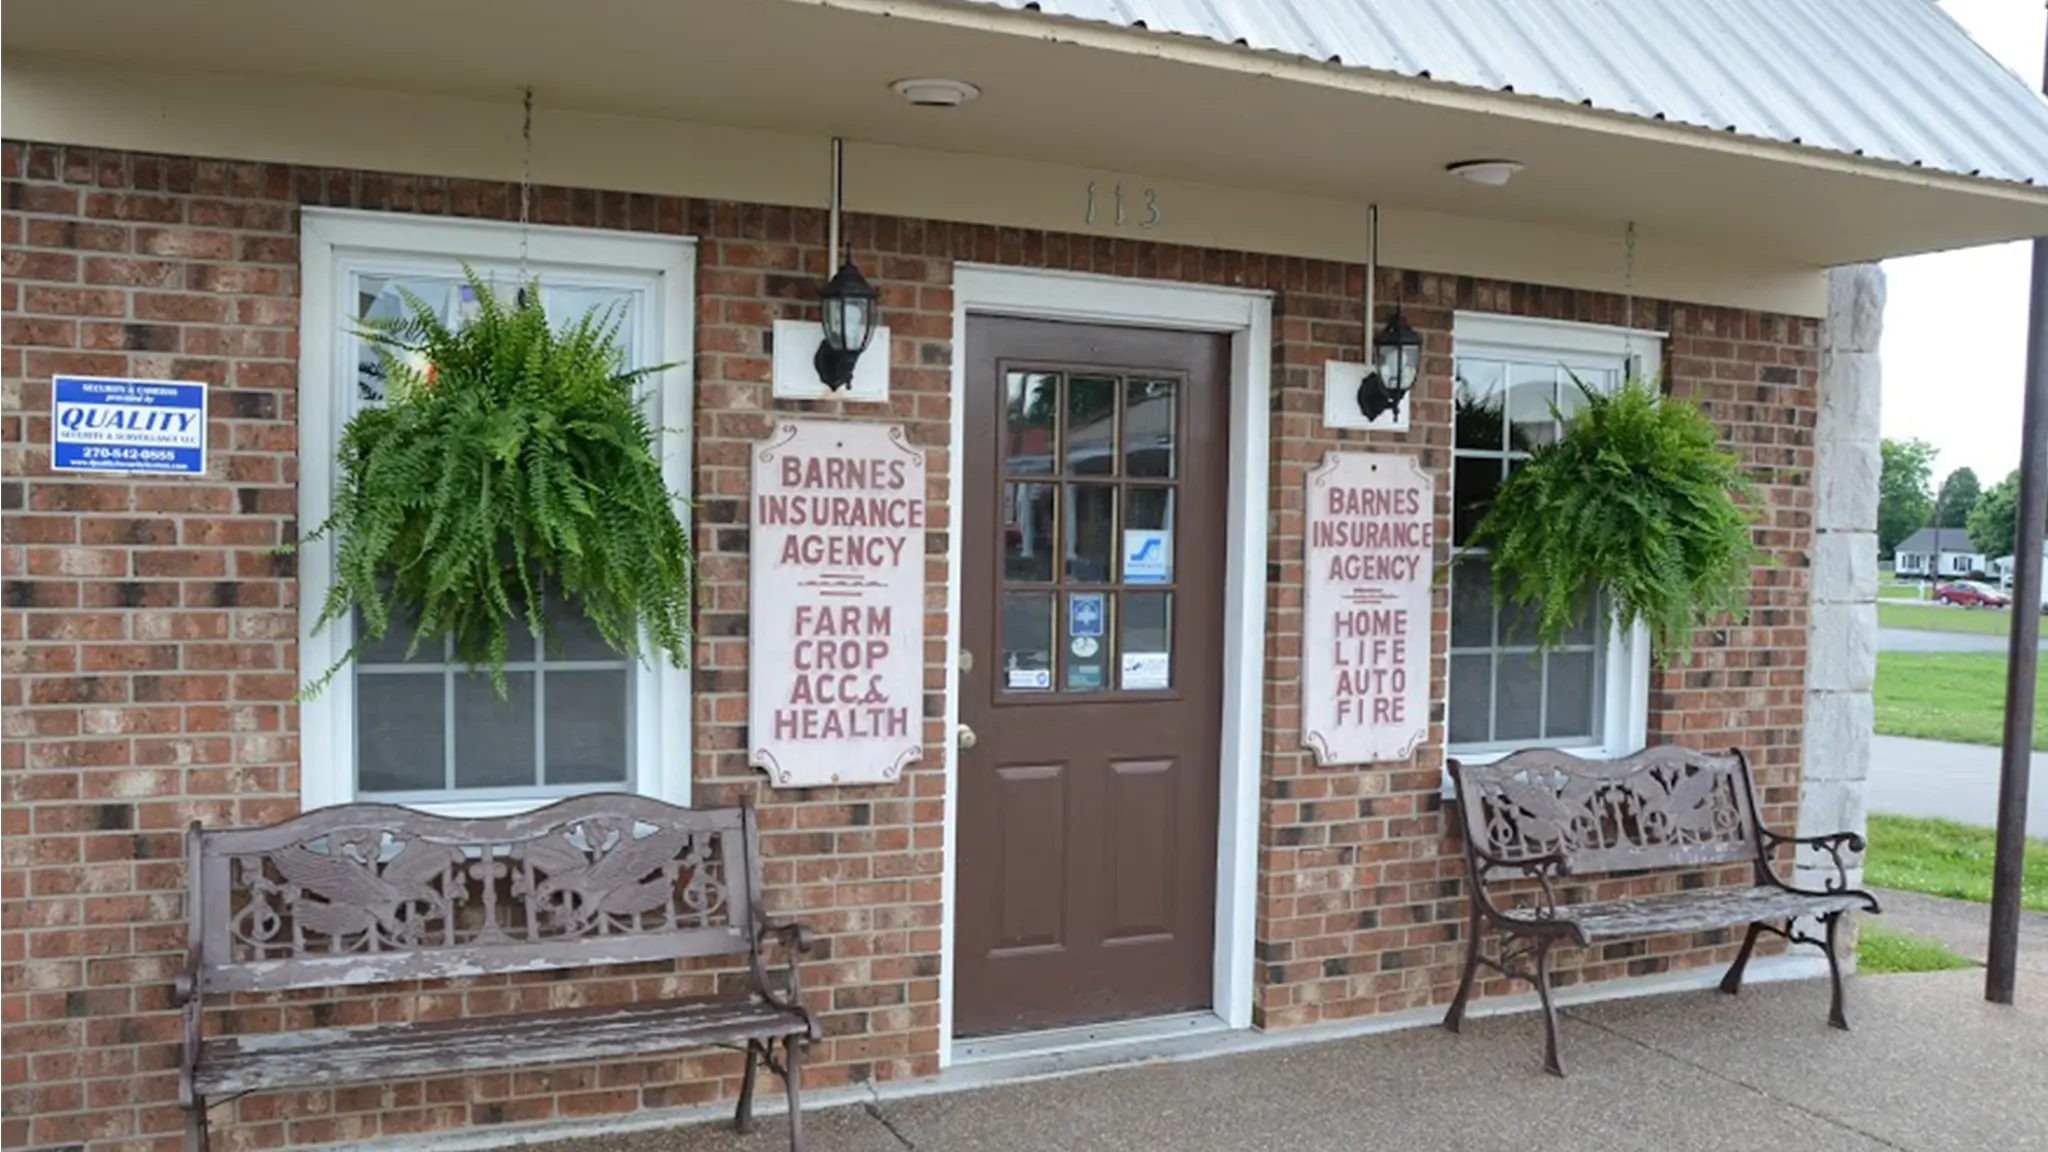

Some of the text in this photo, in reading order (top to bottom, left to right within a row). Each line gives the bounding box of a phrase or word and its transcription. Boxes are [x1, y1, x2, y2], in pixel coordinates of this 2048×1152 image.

[1085, 181, 1159, 229] 113
[61, 407, 197, 431] QUALITY
[781, 455, 906, 490] BARNES
[758, 495, 922, 528] INSURANCE
[1329, 486, 1420, 516] BARNES
[1313, 520, 1432, 549] INSURANCE
[780, 534, 907, 567] AGENCY
[1329, 554, 1420, 581] AGENCY
[795, 605, 891, 636] FARM
[1335, 609, 1407, 638] HOME
[793, 640, 889, 671] CROP
[1334, 639, 1405, 667] LIFE
[1336, 668, 1406, 697] AUTO
[774, 708, 908, 740] HEALTH
[1337, 697, 1405, 726] FIRE
